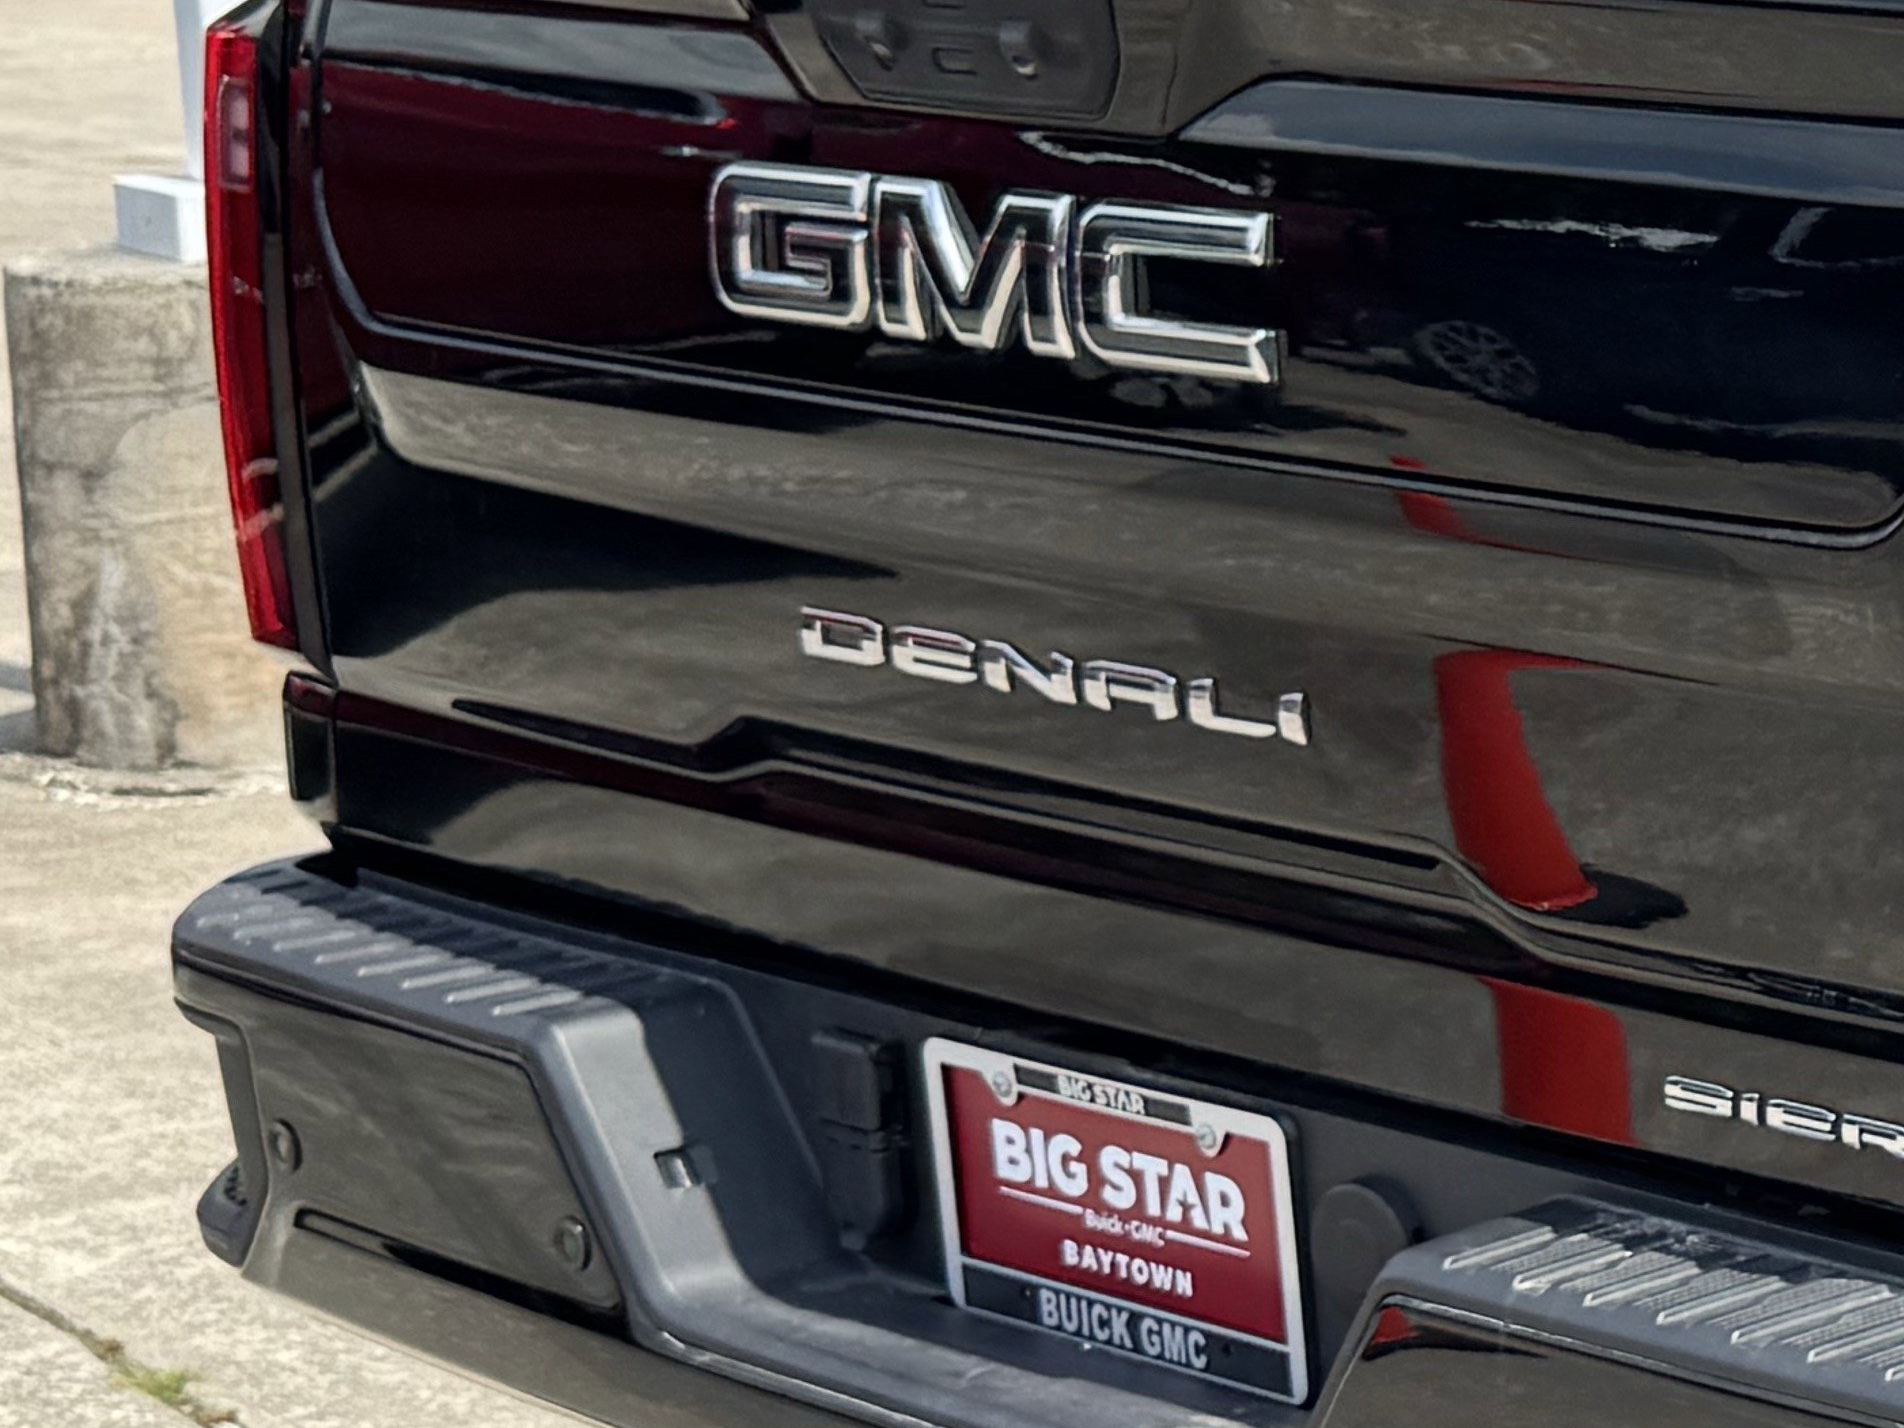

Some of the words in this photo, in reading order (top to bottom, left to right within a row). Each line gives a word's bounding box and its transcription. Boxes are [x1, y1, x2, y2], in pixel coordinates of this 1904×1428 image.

[708, 160, 1284, 386] GMC
[797, 604, 1310, 746] DENALI
[1057, 1074, 1091, 1102] BIG
[1092, 1083, 1146, 1116] STAR
[989, 1117, 1089, 1198] BIG
[1099, 1144, 1250, 1242] STAR
[1061, 1238, 1194, 1298] BAYTOWN
[1038, 1288, 1134, 1350] BUICK
[1139, 1315, 1209, 1371] GMC
